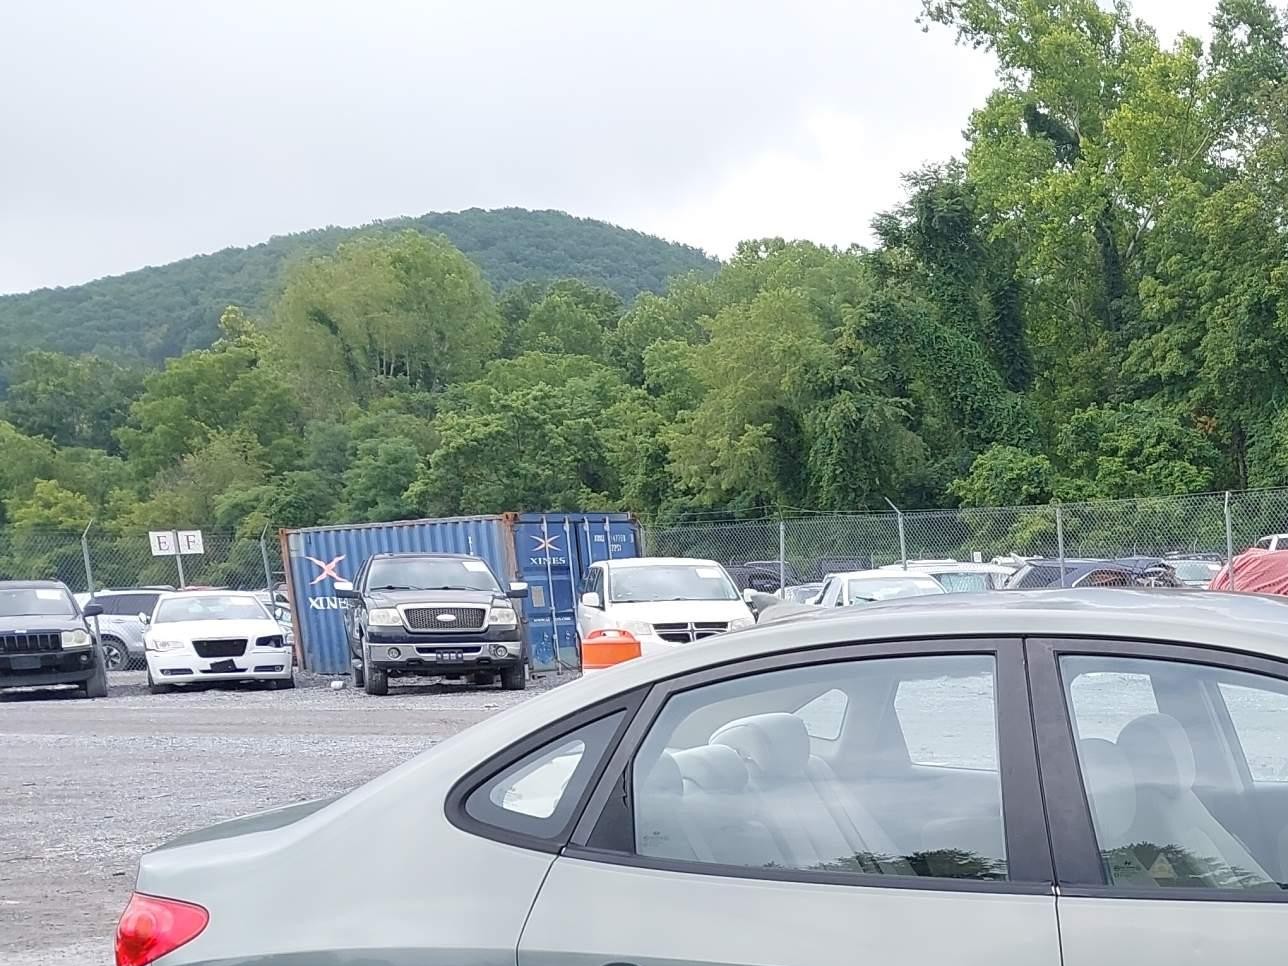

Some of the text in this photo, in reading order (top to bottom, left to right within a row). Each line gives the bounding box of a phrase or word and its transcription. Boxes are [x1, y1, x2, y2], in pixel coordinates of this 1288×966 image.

[156, 535, 170, 551] E
[184, 534, 196, 550] F
[308, 596, 352, 610] XINE
